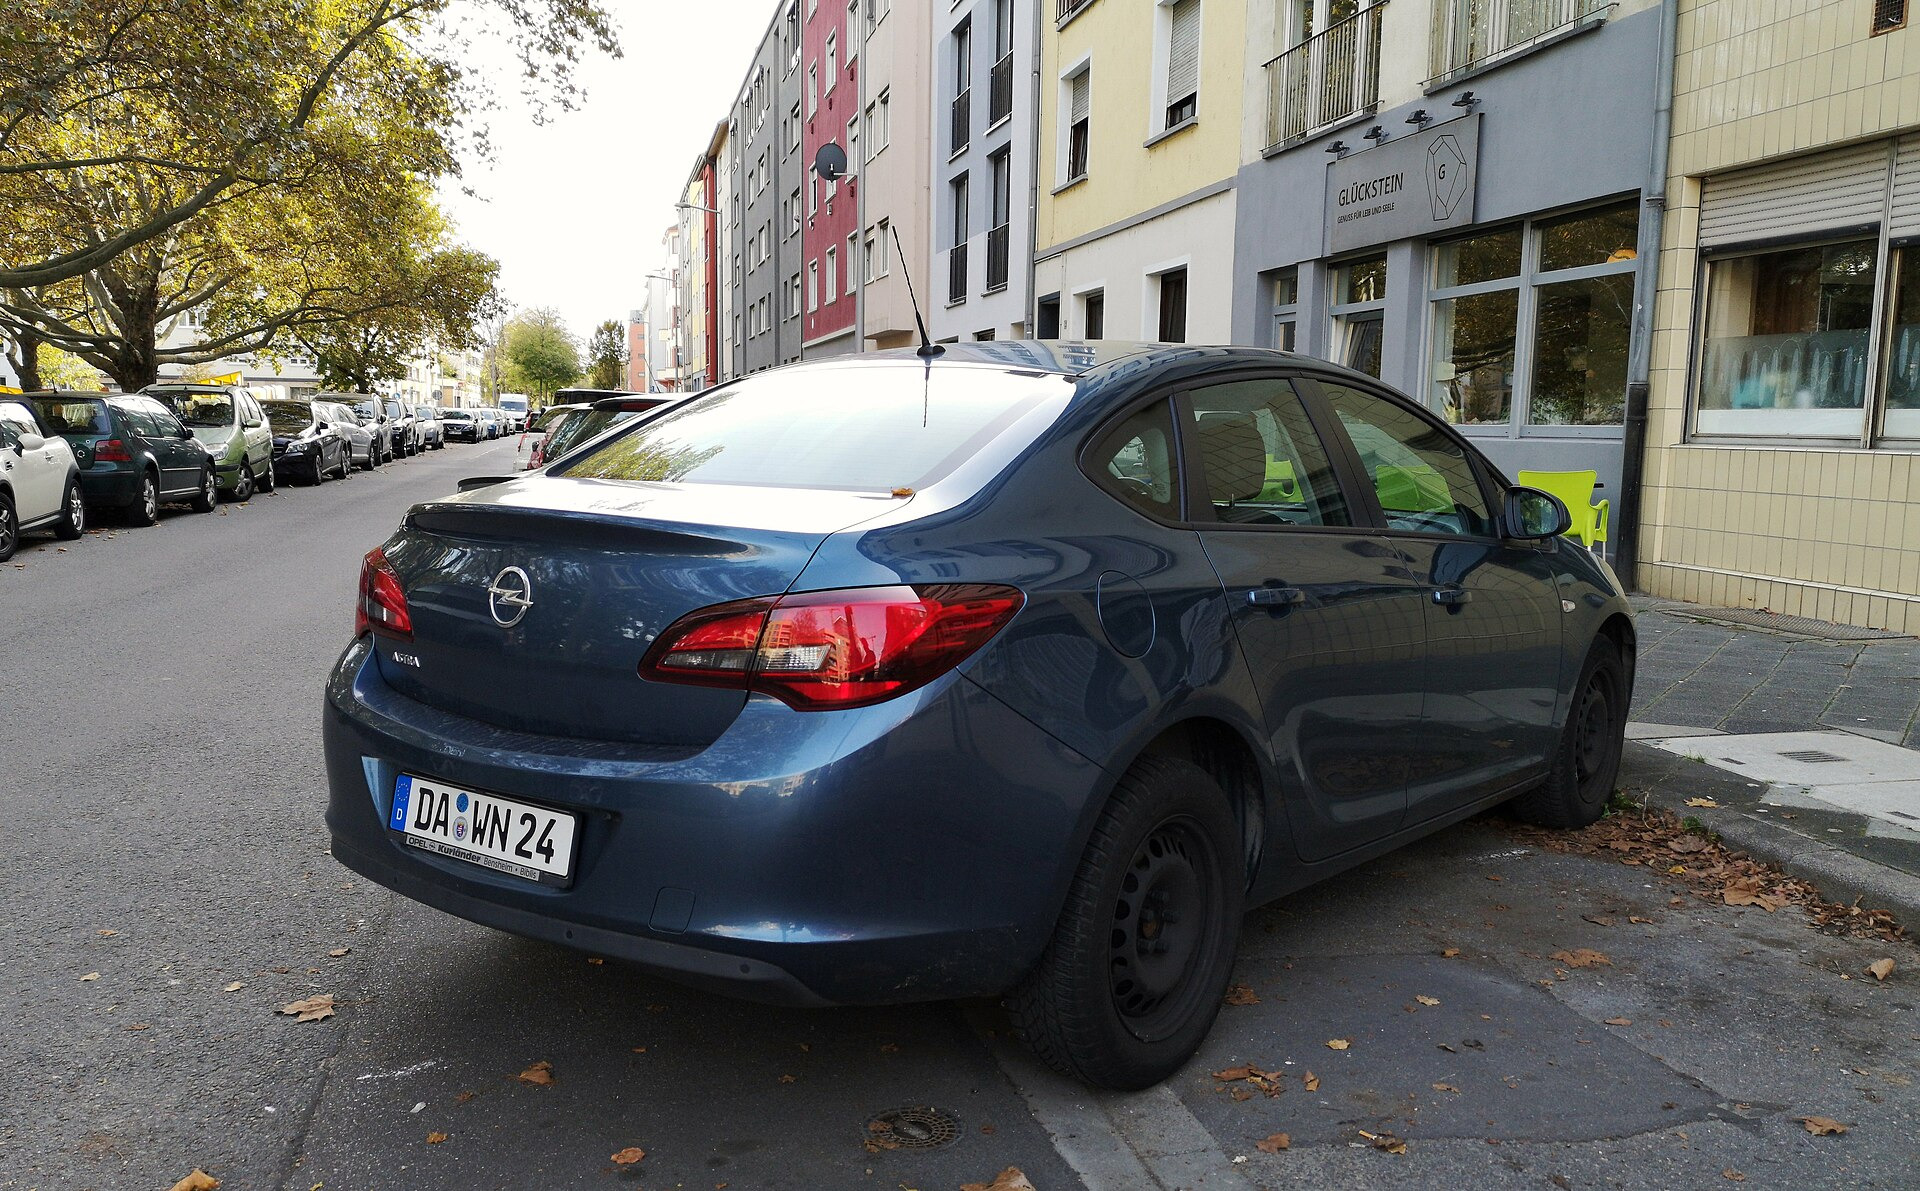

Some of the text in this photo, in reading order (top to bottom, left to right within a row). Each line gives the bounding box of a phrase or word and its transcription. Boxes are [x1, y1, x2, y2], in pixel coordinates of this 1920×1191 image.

[1438, 164, 1446, 180] G
[1338, 172, 1404, 207] GLÜCKSTEIN
[1337, 202, 1395, 224] GENUSS FÜR LEIB UND SEELE
[392, 651, 420, 668] ASTRA
[395, 808, 403, 821] D
[414, 787, 557, 864] DA WN 24
[408, 836, 537, 880] OPEL Kurländer Bensheim Biblis
